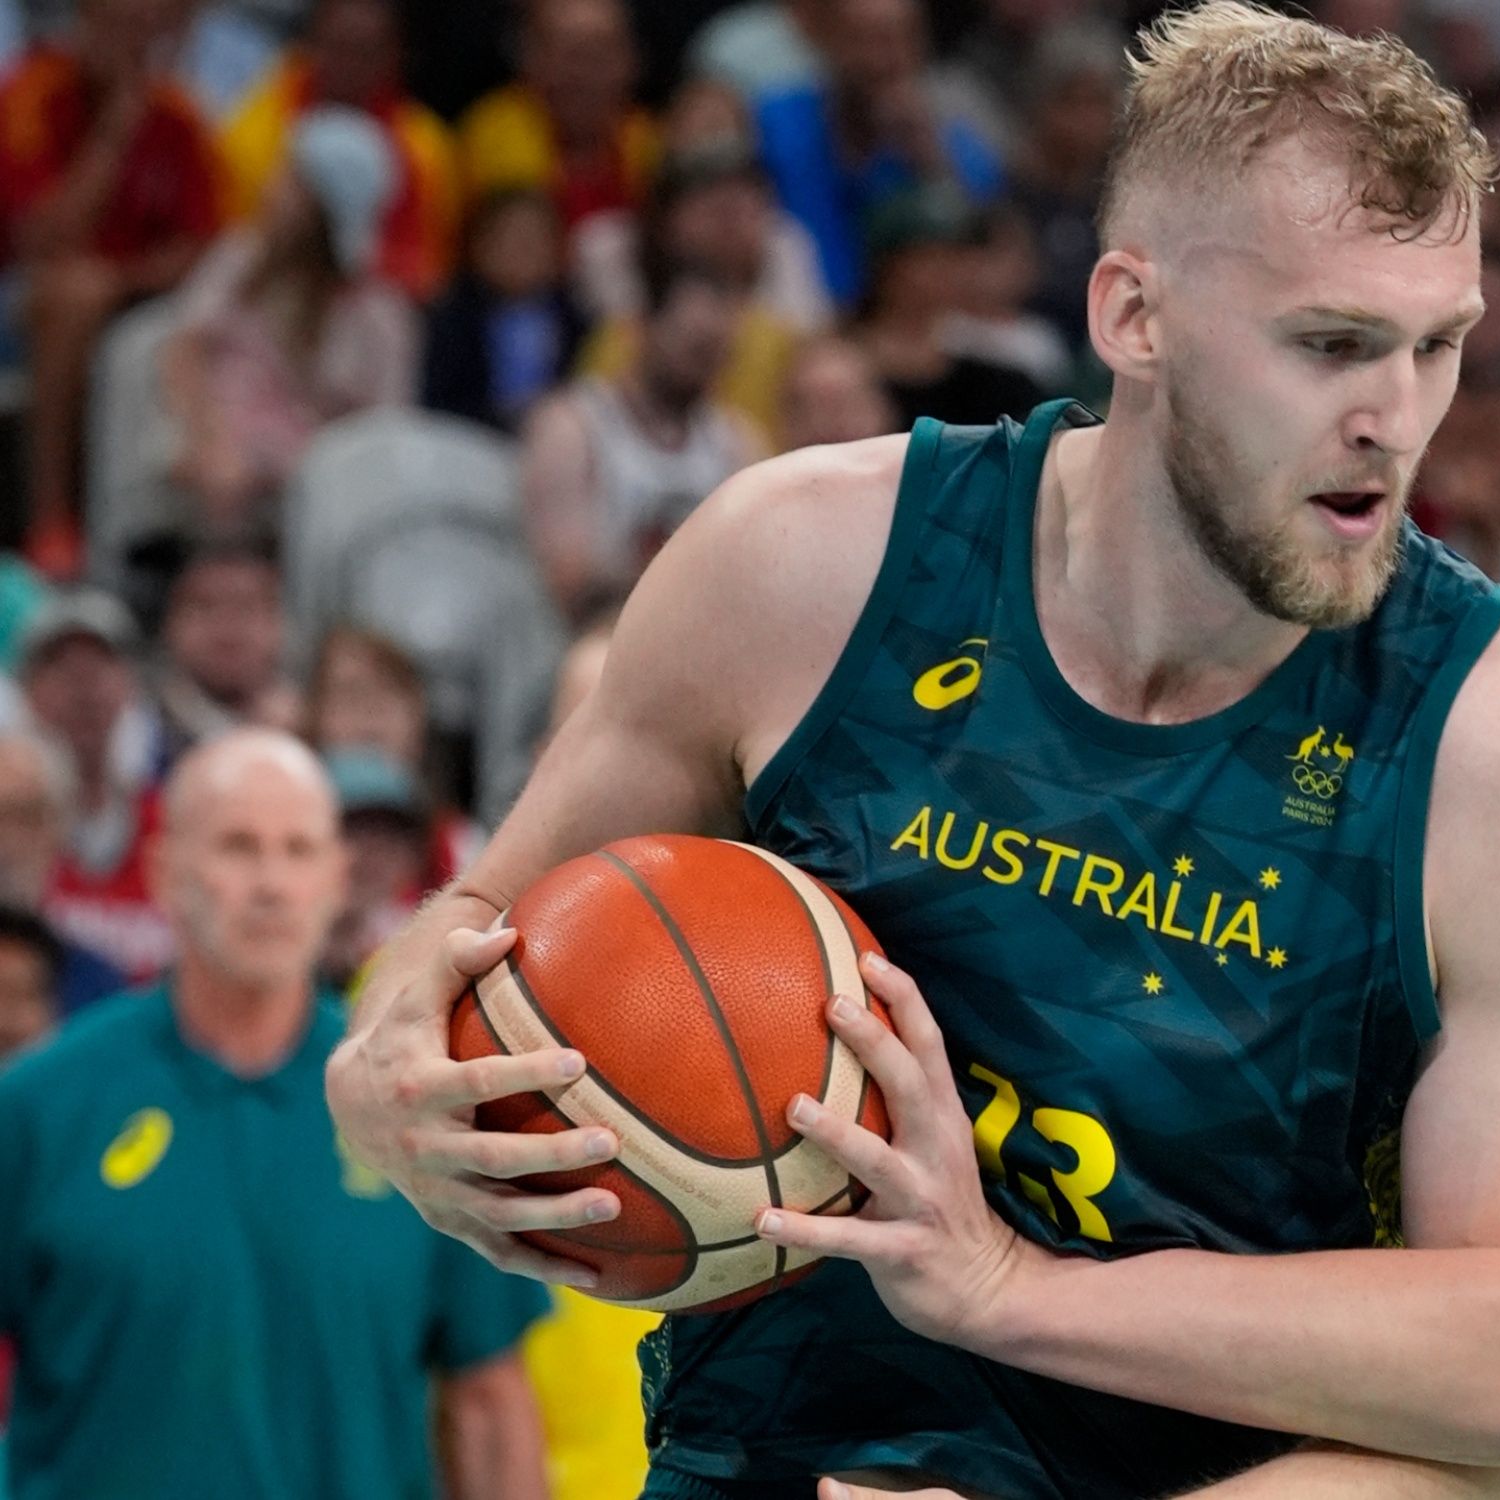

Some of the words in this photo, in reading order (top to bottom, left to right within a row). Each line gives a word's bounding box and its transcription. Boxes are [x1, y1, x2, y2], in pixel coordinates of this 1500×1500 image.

[1282, 806, 1309, 822] PARIS
[1285, 796, 1335, 815] AUSTRALIA
[890, 806, 1262, 959] AUSTRALIA
